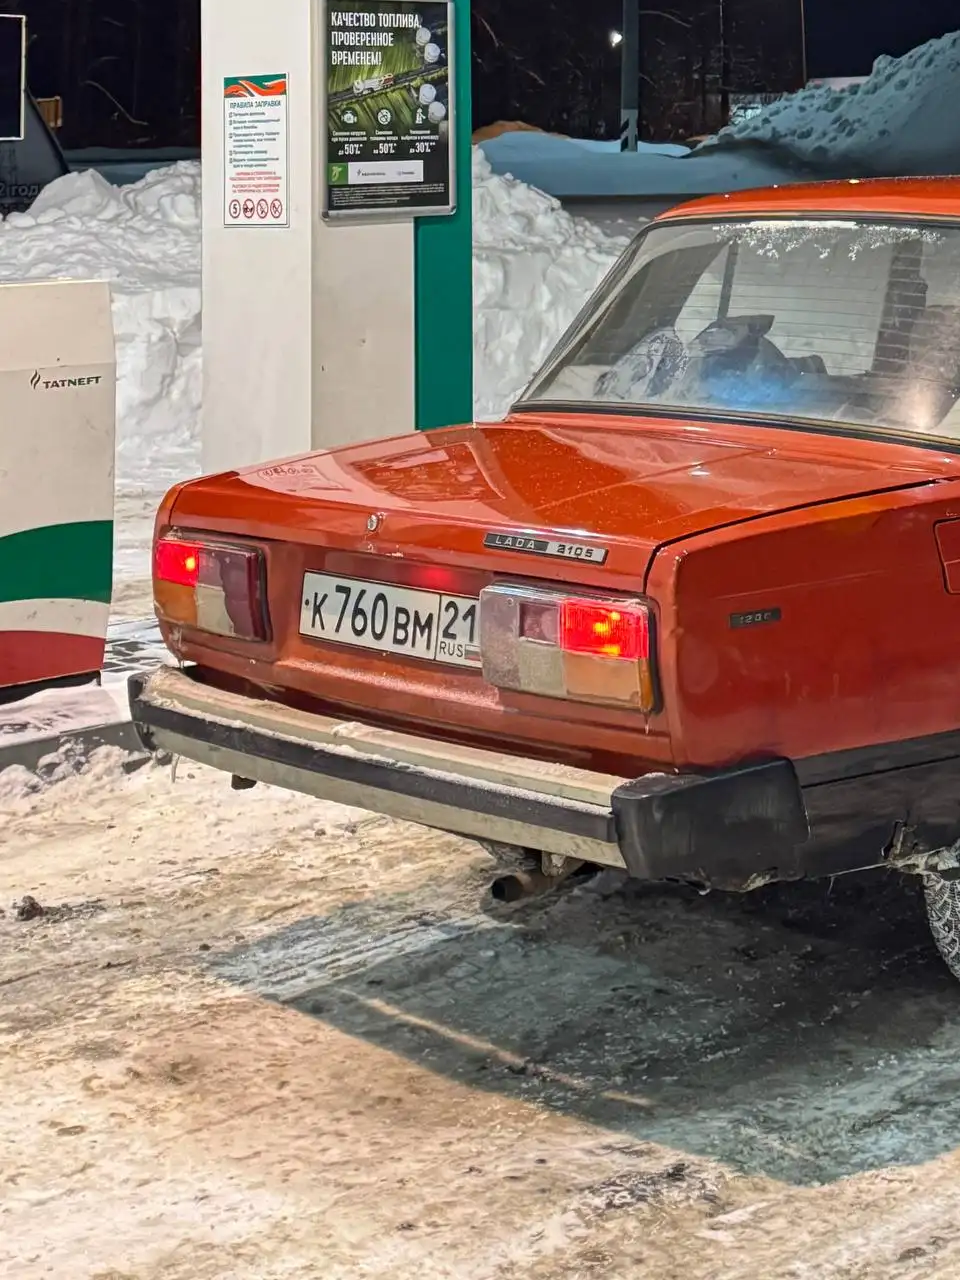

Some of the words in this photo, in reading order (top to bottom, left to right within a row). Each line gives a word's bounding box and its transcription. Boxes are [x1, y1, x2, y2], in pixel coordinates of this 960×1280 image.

[331, 11, 376, 28] КАЧЕСТВО
[331, 31, 394, 47] ПРОВЕРЕННОЕ
[331, 50, 382, 66] ВРЕМЕНЕМ!
[42, 376, 102, 389] TATNEFT
[495, 535, 535, 550] LADA
[557, 544, 595, 559] 2105
[442, 600, 477, 643] 21
[439, 641, 464, 658] RUS
